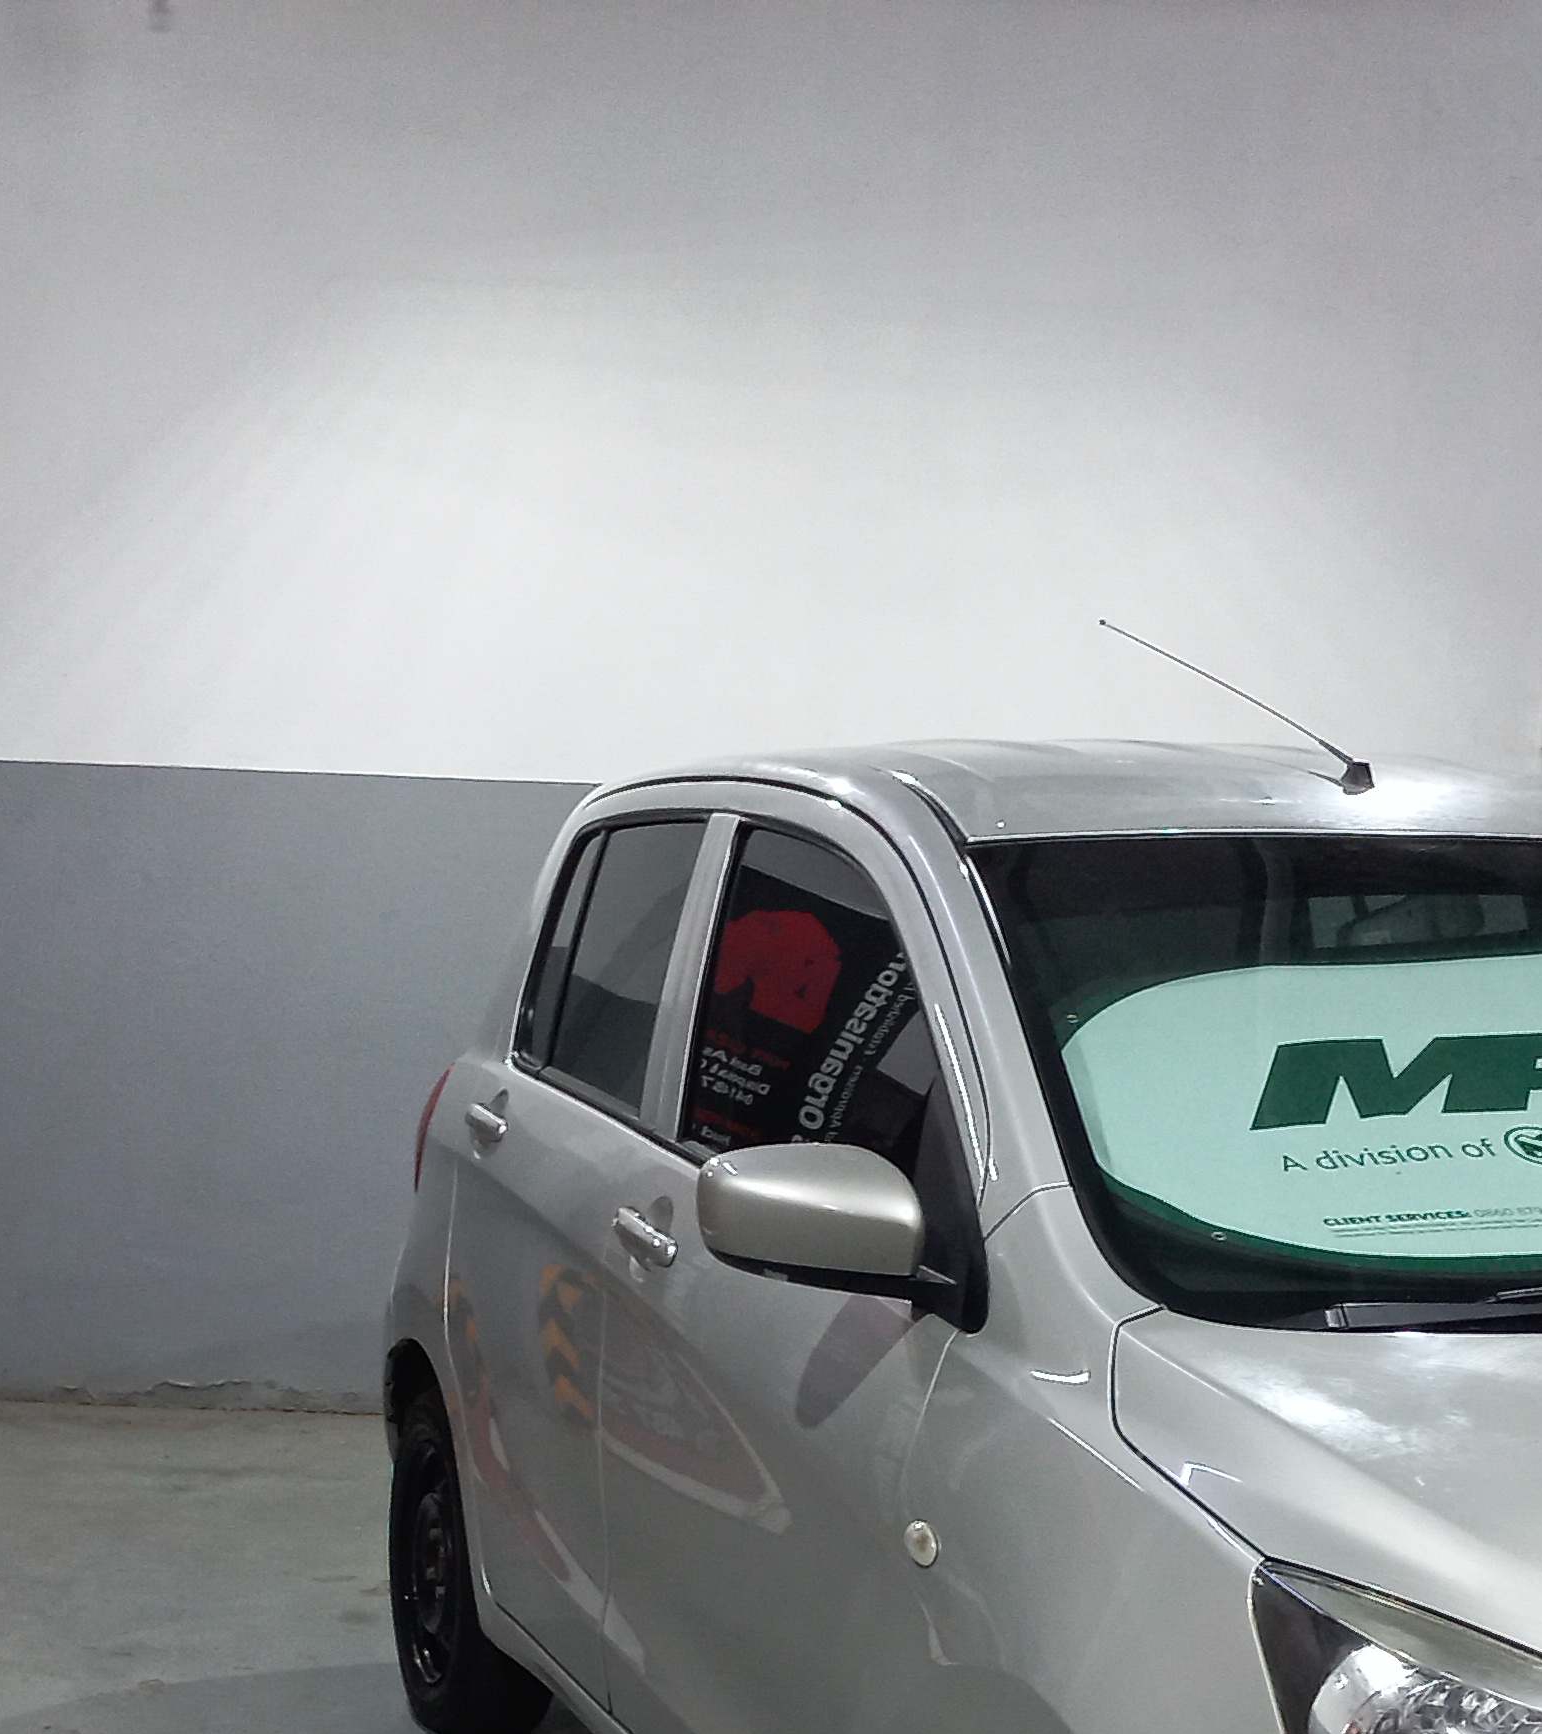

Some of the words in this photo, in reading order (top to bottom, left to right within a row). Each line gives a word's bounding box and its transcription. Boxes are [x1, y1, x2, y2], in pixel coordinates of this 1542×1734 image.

[1281, 1153, 1308, 1174] A
[1316, 1140, 1454, 1172] division
[1461, 1136, 1495, 1160] of
[1323, 1213, 1383, 1228] CLIENT
